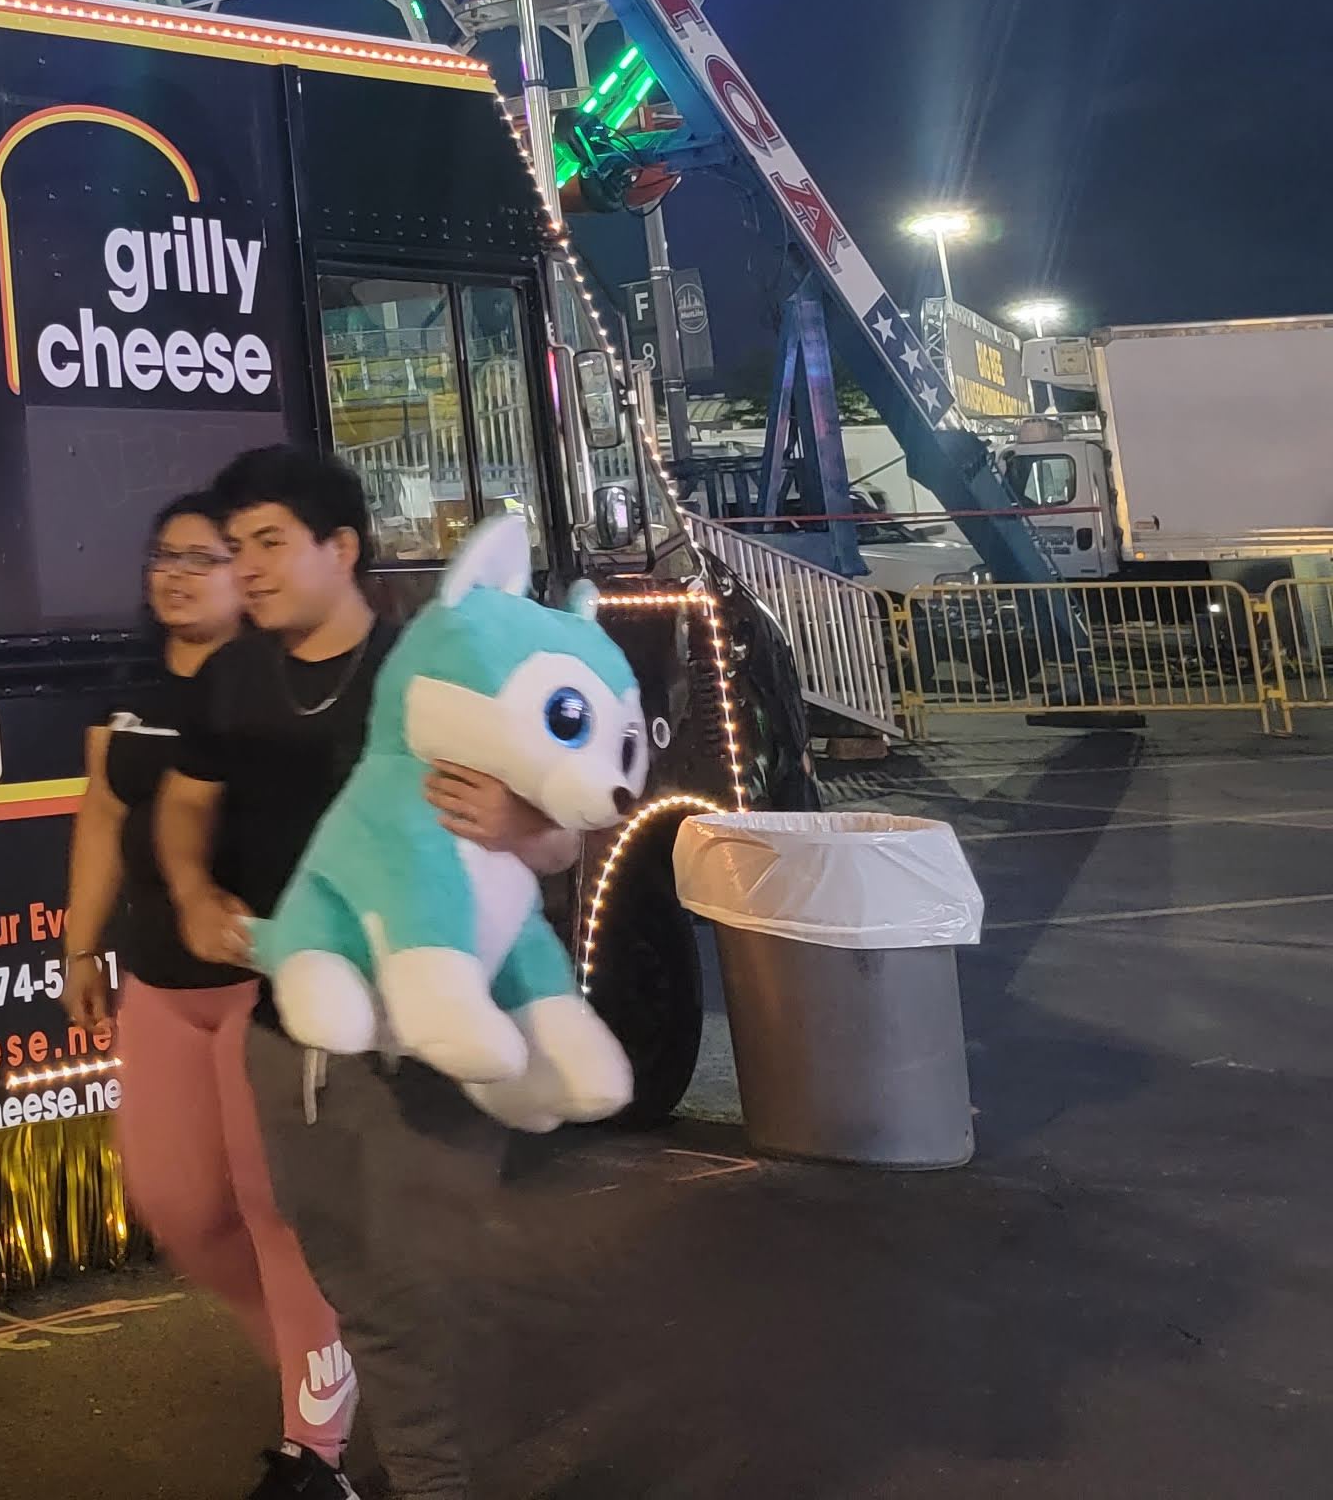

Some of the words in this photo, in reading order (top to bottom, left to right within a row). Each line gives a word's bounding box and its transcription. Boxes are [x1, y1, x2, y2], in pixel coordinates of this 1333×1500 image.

[104, 215, 262, 315] grilly
[634, 292, 649, 321] F
[37, 308, 273, 395] cheese
[306, 1339, 352, 1392] NI
